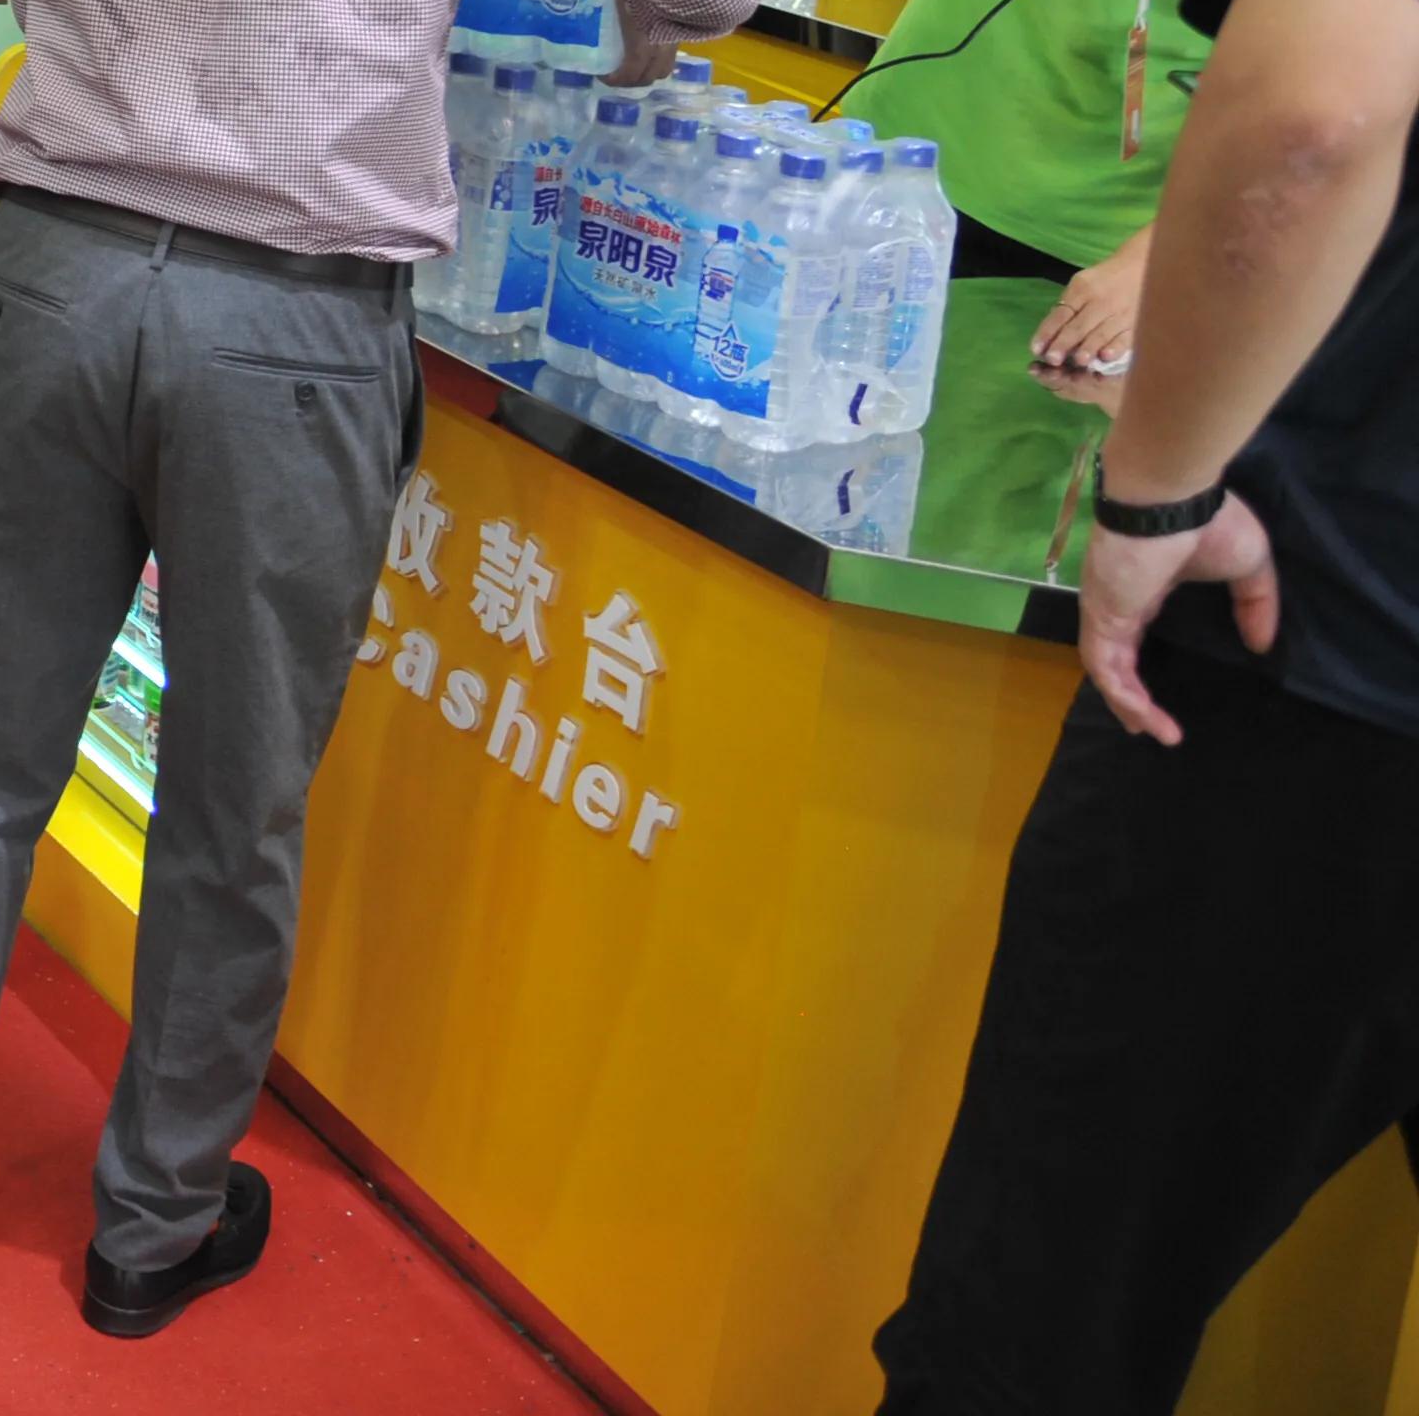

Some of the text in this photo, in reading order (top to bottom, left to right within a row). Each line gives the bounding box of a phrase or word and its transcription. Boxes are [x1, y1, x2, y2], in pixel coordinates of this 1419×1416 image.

[576, 220, 679, 288] 泉阳泉
[385, 472, 666, 734] 收款台
